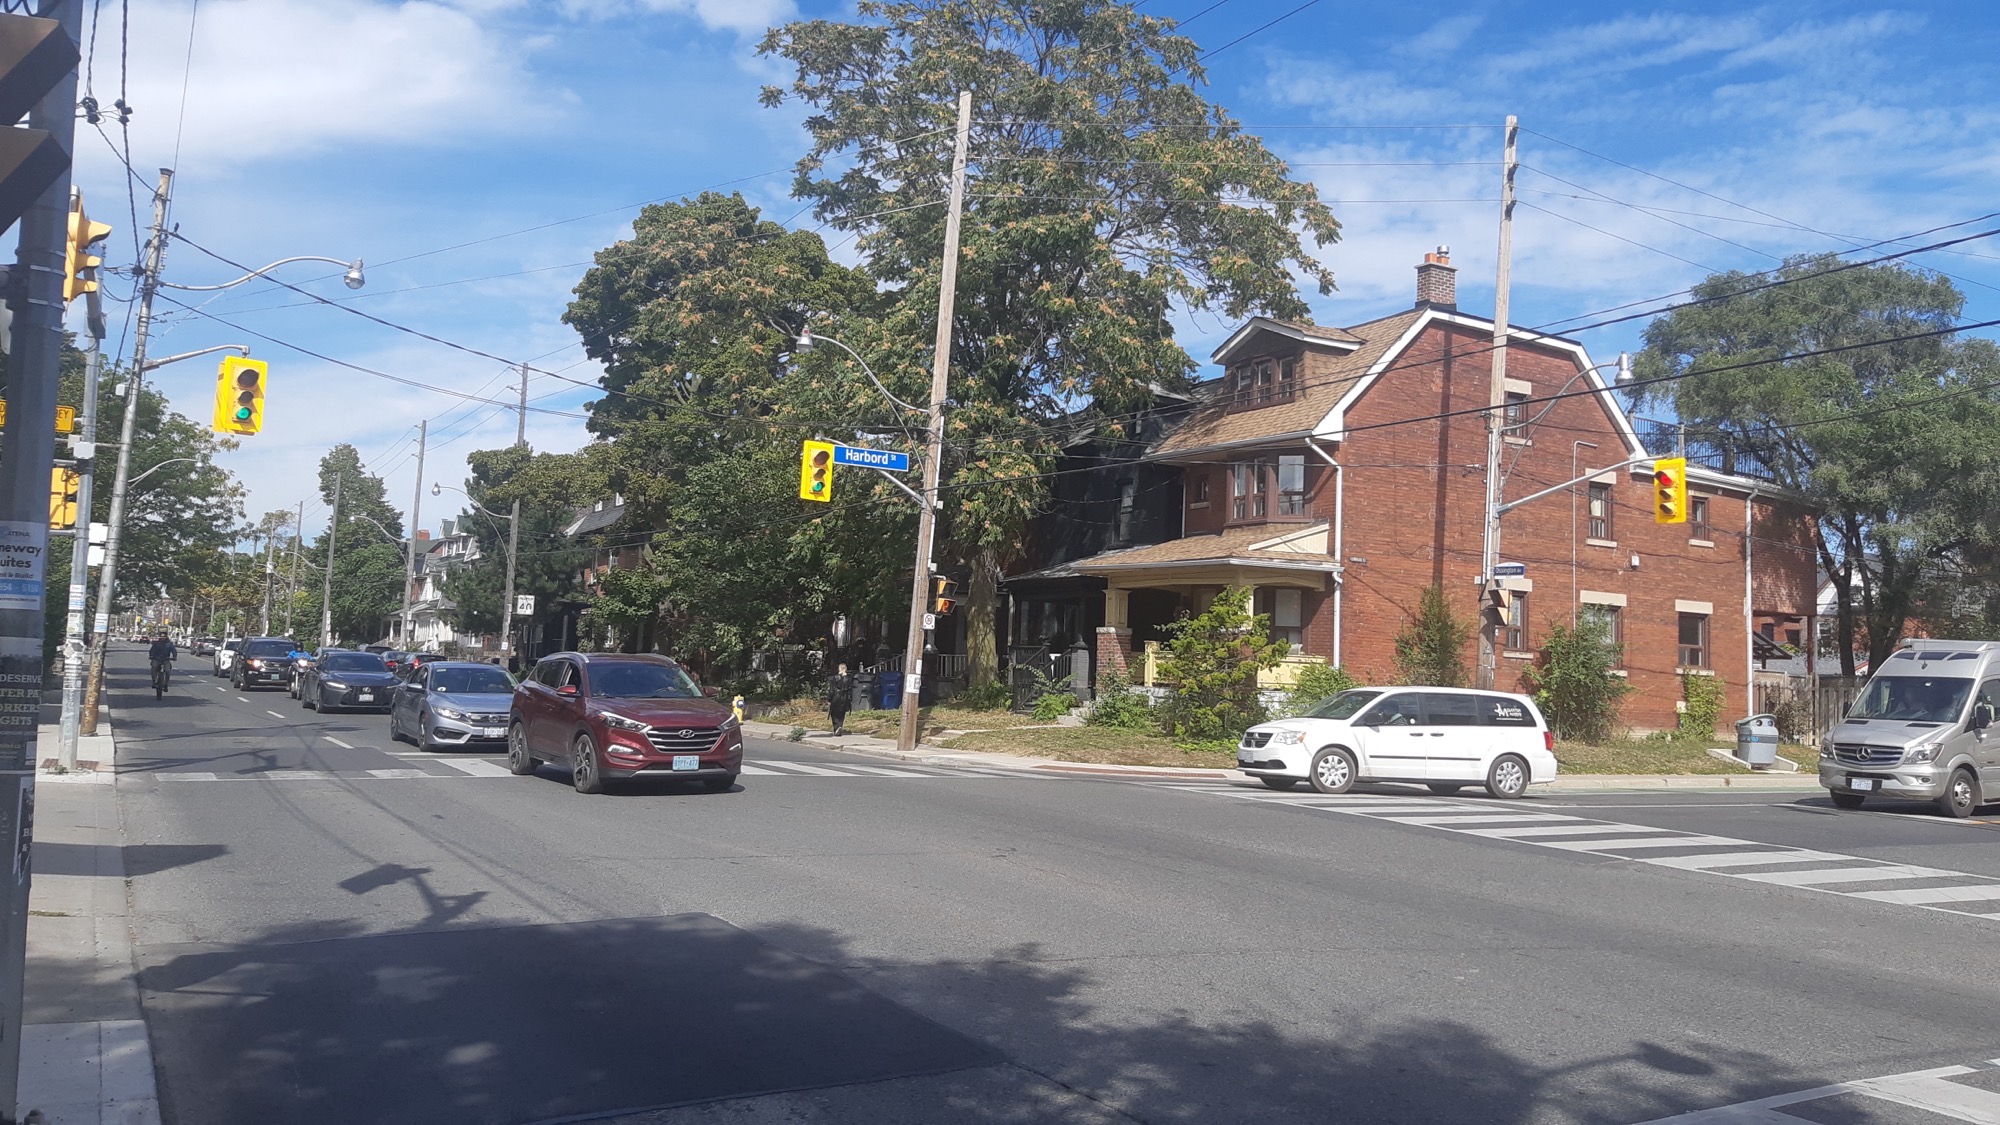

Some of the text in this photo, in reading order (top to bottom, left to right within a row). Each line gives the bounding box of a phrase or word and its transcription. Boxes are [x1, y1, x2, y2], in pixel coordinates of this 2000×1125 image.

[845, 448, 889, 465] Harbord
[1495, 567, 1516, 575] Ossington
[519, 602, 532, 611] 40
